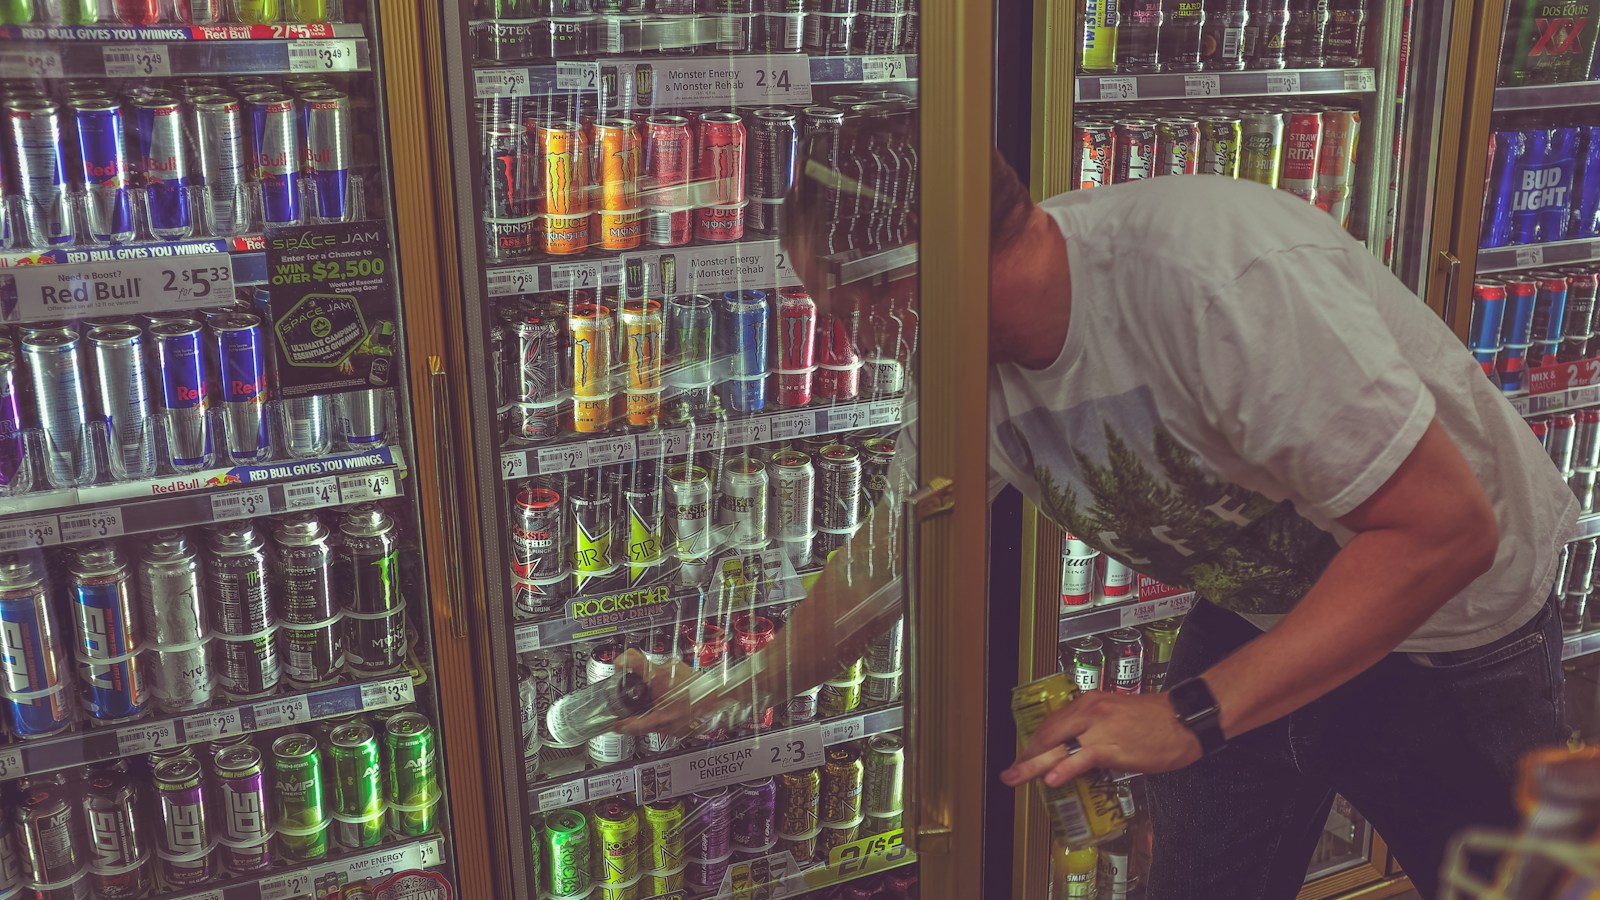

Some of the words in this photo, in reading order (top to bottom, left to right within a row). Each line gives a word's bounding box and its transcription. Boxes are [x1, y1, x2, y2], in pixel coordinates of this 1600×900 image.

[1542, 6, 1561, 16] DOS
[1562, 5, 1589, 16] EQUIS
[1085, 0, 1097, 49] TWISTE
[22, 28, 47, 40] RED
[48, 28, 75, 40] BULL
[77, 28, 110, 40] GIVES
[112, 29, 137, 39] YOU
[205, 30, 228, 39] Red
[229, 30, 251, 39] Bull
[668, 69, 706, 80] Monster
[708, 68, 739, 82] Energy
[756, 70, 767, 86] 2
[665, 83, 671, 92] &
[673, 80, 711, 91] Monster
[715, 79, 744, 90] Rehab
[1289, 133, 1318, 142] STRAW
[1324, 130, 1347, 138] EACH
[1287, 149, 1316, 160] RITA
[1521, 167, 1561, 191] BUD
[1513, 187, 1567, 211] LIGHT
[273, 231, 337, 251] SPACE
[341, 232, 380, 244] JAM
[67, 251, 88, 263] RED
[91, 249, 113, 261] BULL
[117, 247, 148, 259] GIVES
[151, 245, 172, 257] YOU
[281, 255, 305, 263] Enter
[307, 253, 318, 261] for
[328, 250, 361, 259] Chance
[691, 257, 729, 268] Monster
[729, 255, 761, 269] Energy
[775, 253, 785, 270] 2
[58, 273, 82, 282] Need
[91, 270, 122, 279] Boost?
[276, 263, 305, 274] WIN
[312, 257, 385, 282] $2,500
[694, 268, 734, 279] Monster
[736, 266, 765, 276] Rehab
[162, 270, 177, 292] 2
[272, 274, 311, 285] OVER
[41, 282, 88, 304] Red
[95, 278, 140, 300] Bull
[283, 307, 325, 334] SPACE
[327, 301, 351, 313] JAM
[291, 339, 324, 352] ULTIMATE
[324, 322, 358, 345] CAMPING
[293, 345, 331, 360] ESSENTIALS
[331, 328, 361, 350] GIVEAWAY
[1531, 371, 1549, 382] MIX
[1550, 370, 1556, 379] &
[1567, 364, 1578, 386] 2
[1531, 377, 1557, 391] MATCH
[178, 386, 207, 400] Red
[249, 470, 268, 481] RED
[270, 467, 292, 479] BULL
[293, 464, 321, 476] GIVES
[321, 460, 342, 472] YOU
[152, 483, 176, 495] Red
[176, 478, 199, 491] Bull
[582, 611, 624, 627] ENERGY
[629, 605, 665, 619] DRINK
[690, 748, 752, 771] ROCKSTAR
[771, 746, 781, 764] 2
[700, 761, 745, 780] ENERGY
[275, 780, 314, 792] AMP
[349, 859, 369, 871] AMP
[370, 851, 405, 869] ENERGY
